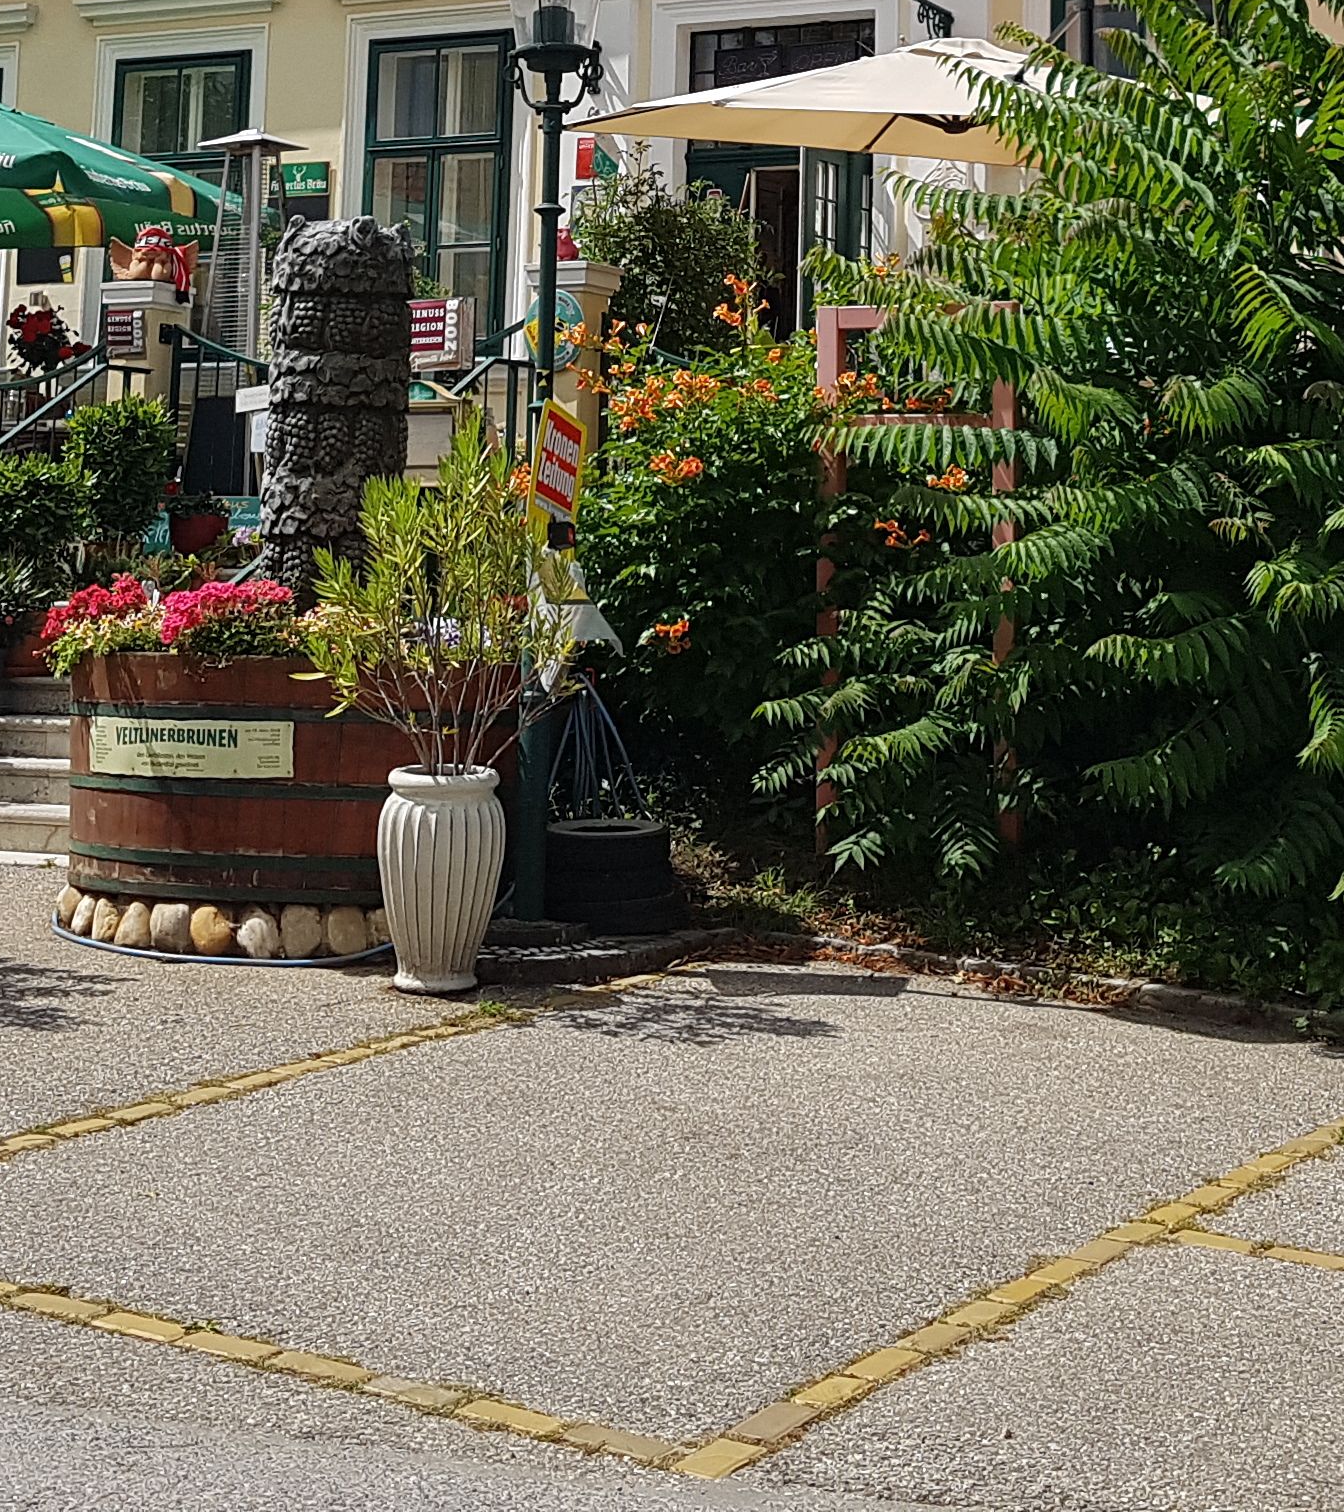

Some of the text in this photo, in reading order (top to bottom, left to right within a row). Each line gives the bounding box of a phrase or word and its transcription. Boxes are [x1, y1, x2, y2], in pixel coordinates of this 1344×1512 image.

[271, 180, 306, 191] Huertus
[543, 418, 580, 468] Kronen
[537, 450, 576, 503] Zeitung
[115, 726, 239, 749] VELTLINERBRUNEN
